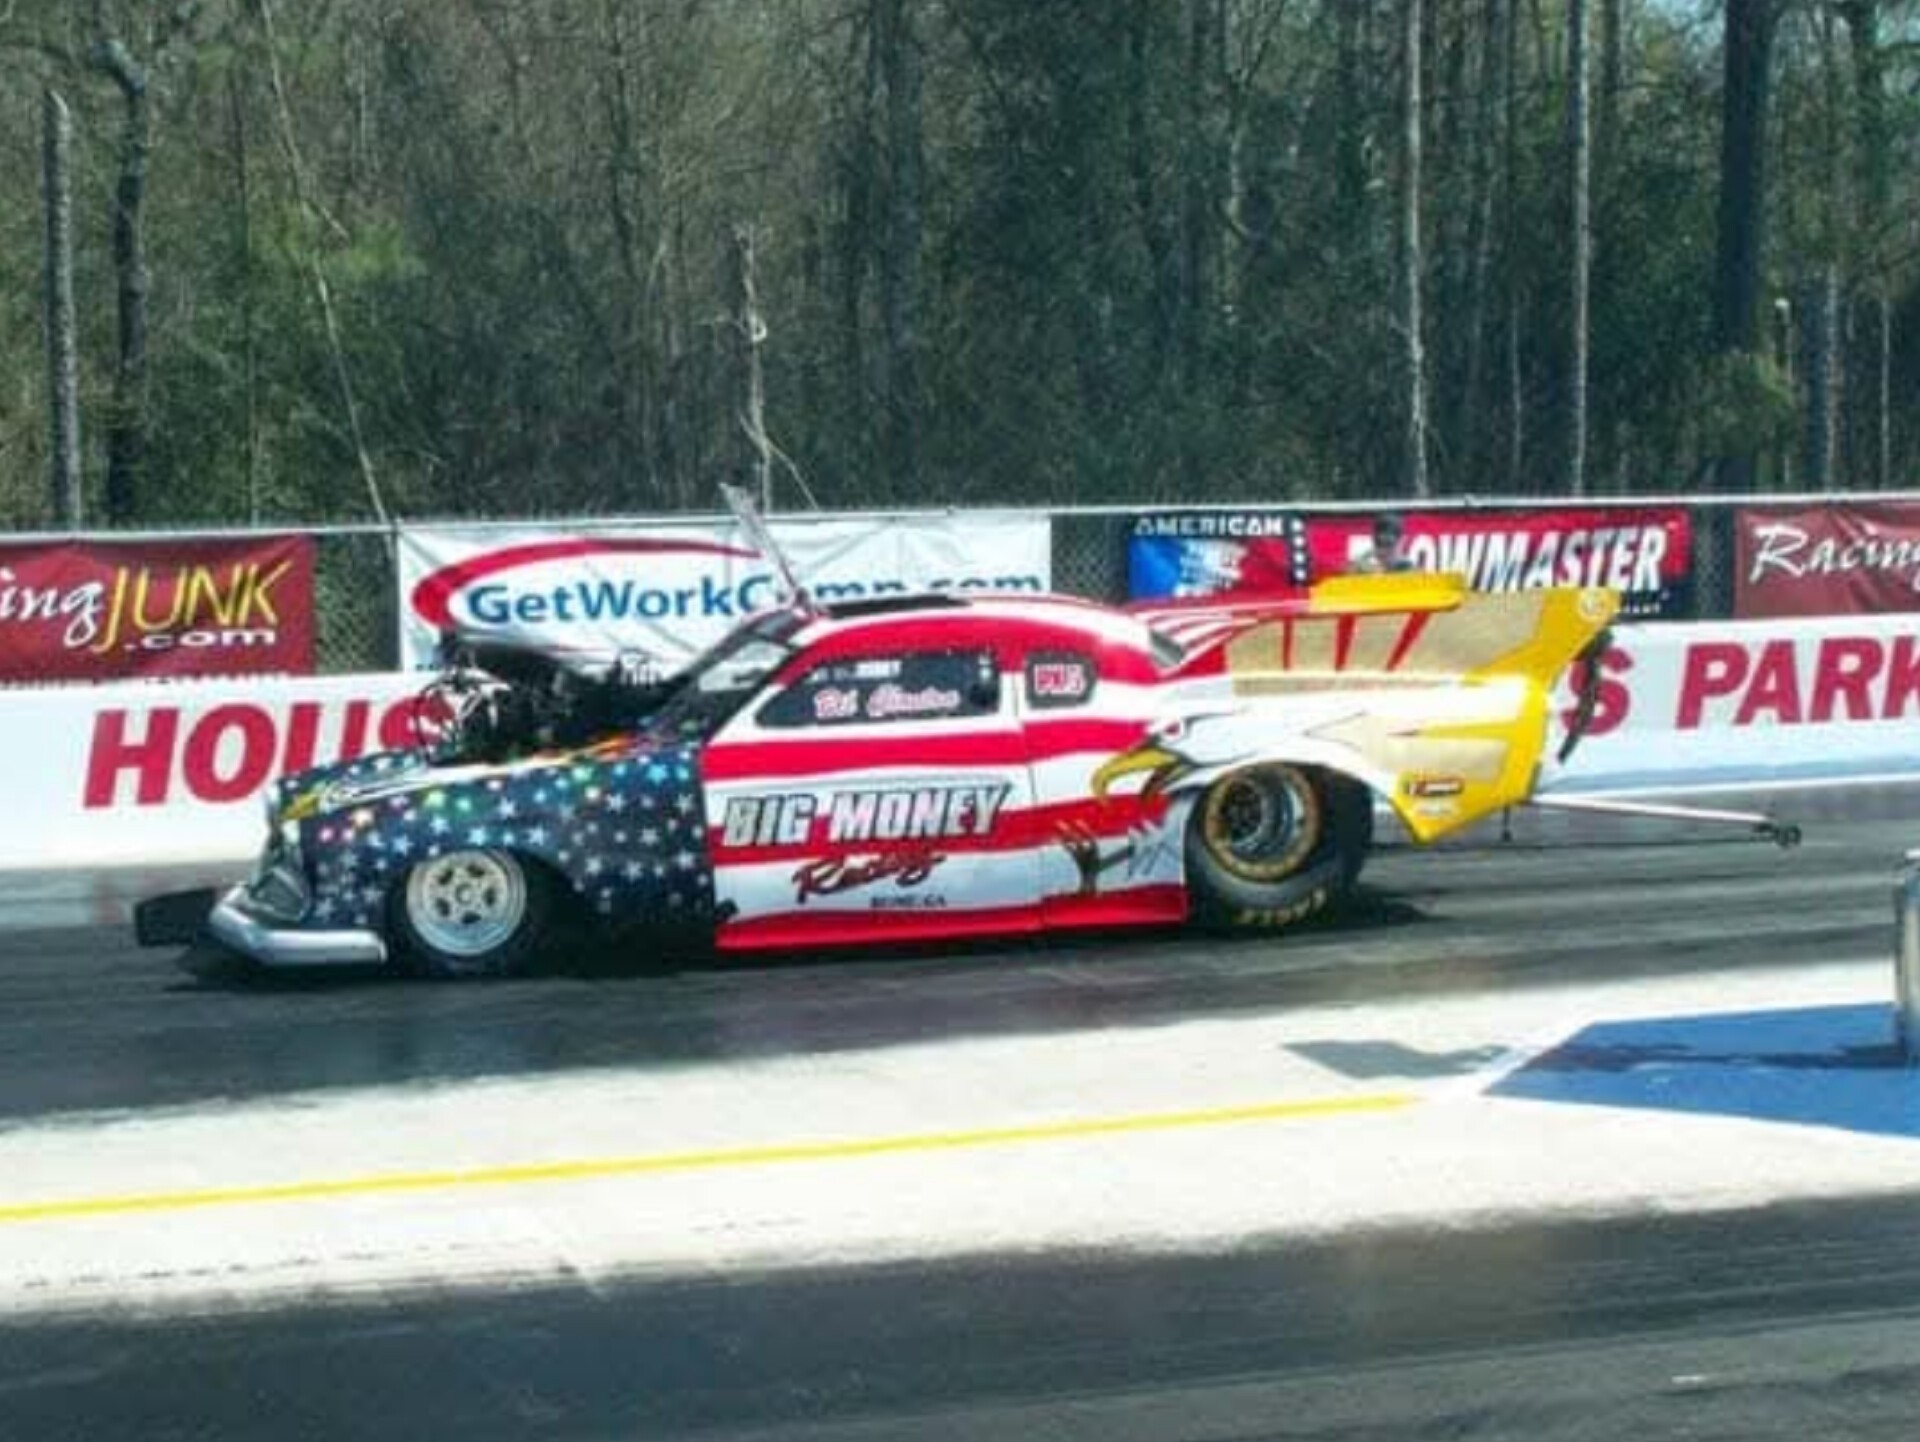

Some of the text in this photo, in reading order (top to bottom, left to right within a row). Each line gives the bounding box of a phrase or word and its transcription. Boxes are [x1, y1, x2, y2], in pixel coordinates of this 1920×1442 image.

[1134, 515, 1284, 536] AMERICAN
[123, 630, 276, 650] .com
[723, 782, 1010, 847] BIG MONEY
